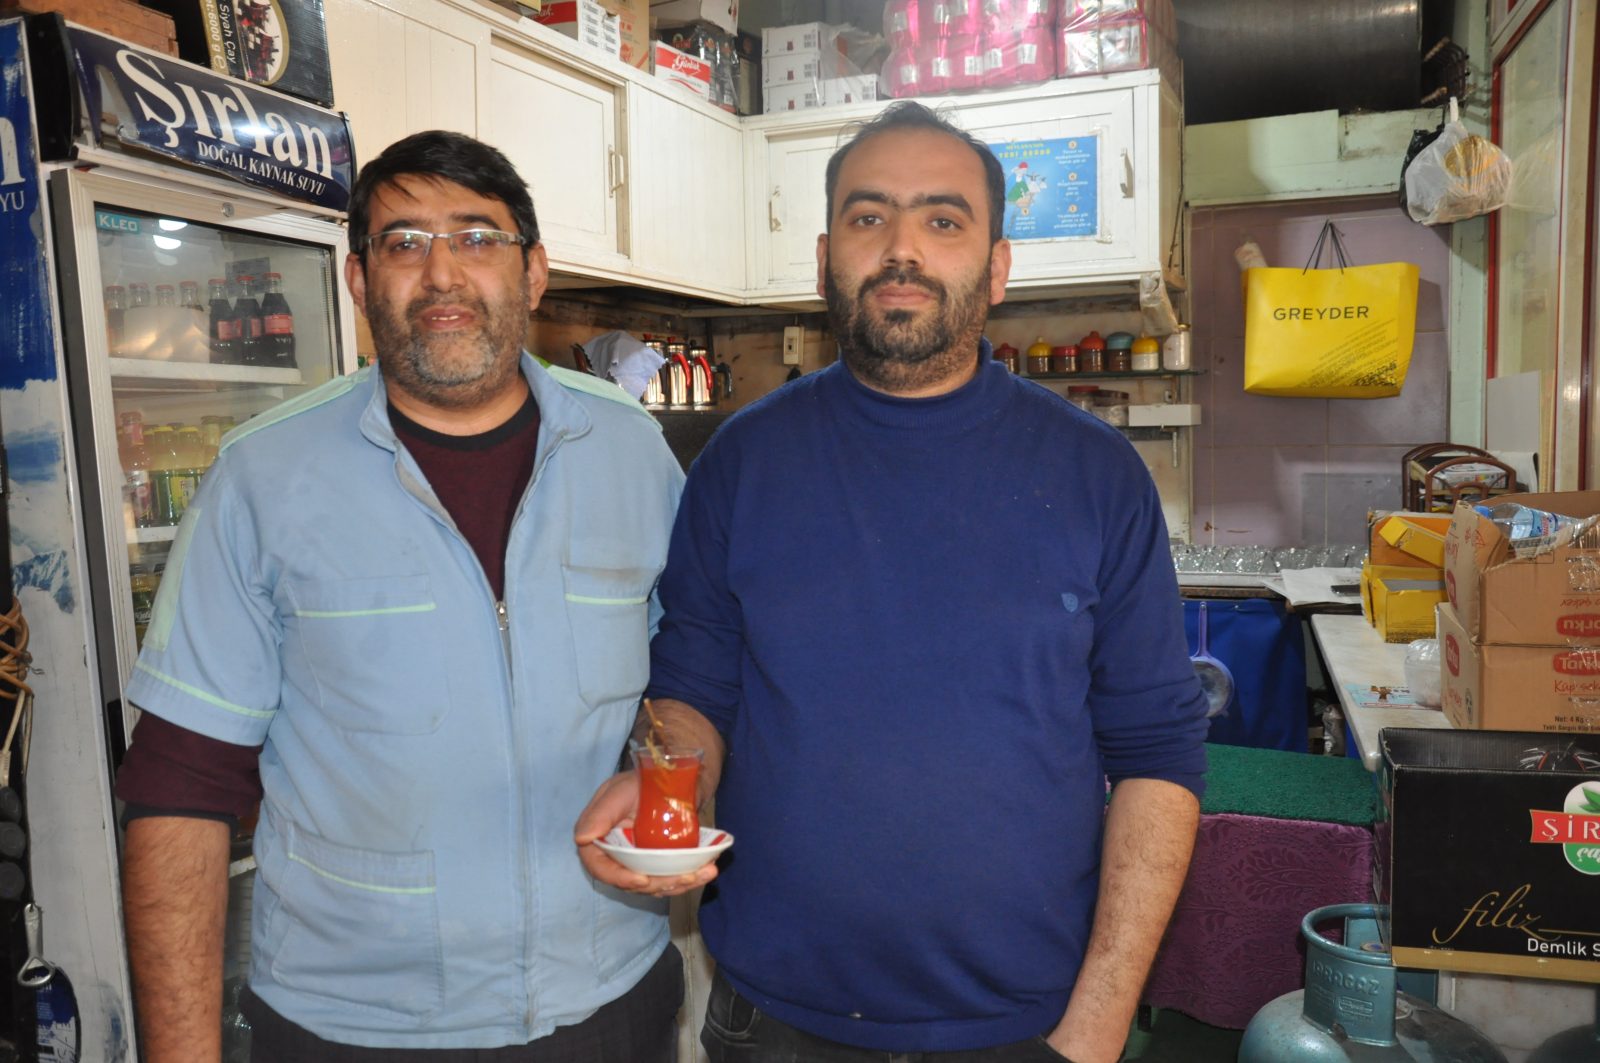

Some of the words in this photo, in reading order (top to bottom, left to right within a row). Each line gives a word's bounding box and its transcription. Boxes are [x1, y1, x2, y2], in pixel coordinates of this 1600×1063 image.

[219, 3, 233, 38] Siyah
[224, 41, 236, 64] Çay
[116, 49, 334, 180] Şırlan
[197, 141, 247, 170] DOĞAL
[249, 157, 297, 187] KAYNAK
[296, 174, 326, 196] SUYU
[1273, 305, 1369, 321] GREYDER
[1432, 883, 1561, 944] filiz
[1527, 938, 1587, 956] Demlik
